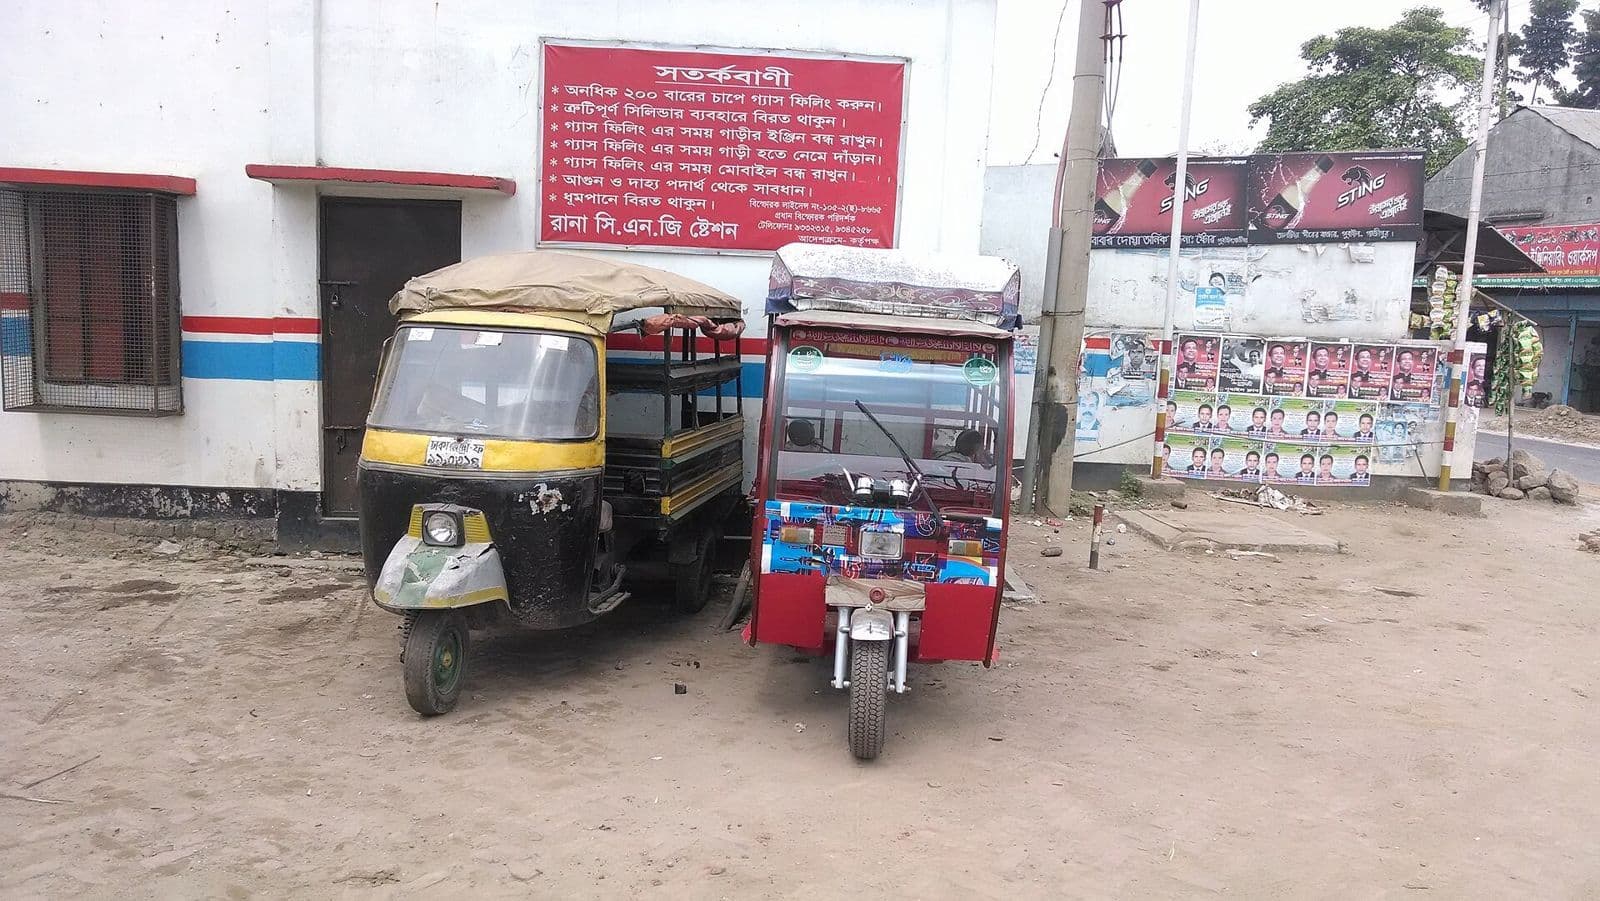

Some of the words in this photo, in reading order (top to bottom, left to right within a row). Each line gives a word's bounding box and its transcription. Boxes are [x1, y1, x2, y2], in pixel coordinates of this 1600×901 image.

[653, 65, 794, 88] সতর্কবাণী
[564, 83, 618, 98] অনধিক
[624, 88, 657, 100] ২০০
[663, 89, 706, 103] বারের
[711, 92, 745, 105] চাপে
[751, 93, 784, 107] গ্যাস
[789, 94, 832, 110] ফিলিং
[624, 103, 684, 120] সিলিন্ডার
[690, 109, 747, 123] ব্যবহারে
[753, 110, 790, 124] বিরত
[564, 120, 598, 133] গ্যাস
[603, 120, 647, 136] ফিলিং
[651, 125, 674, 137] এর
[680, 127, 713, 139] সময়
[719, 126, 762, 143] গাড়ীর
[767, 129, 806, 144] ইঞ্জিন
[811, 133, 834, 146] বন্ধ
[564, 138, 598, 151] গ্যাস
[603, 137, 646, 154] ফিলিং
[651, 143, 674, 155] এর
[680, 144, 713, 157] সময়
[718, 144, 751, 161] গাড়ী
[756, 149, 787, 160] হতে
[793, 150, 826, 163] নেমে
[563, 155, 597, 169] গ্যাস
[603, 155, 646, 172] ফিলিং
[650, 161, 673, 173] এর
[679, 162, 712, 175] সময়
[718, 163, 777, 178] মোবাইল
[784, 167, 806, 180] বন্ধ
[562, 174, 604, 188] আগুন
[610, 178, 622, 188] ও
[628, 178, 660, 191] দাহ্য
[666, 178, 706, 192] পদার্থ
[710, 181, 747, 193] থেকে
[1159, 177, 1211, 214] SNG
[1335, 172, 1388, 210] STING
[563, 192, 618, 207] ধূমপানে
[624, 192, 662, 207] বিরত
[549, 213, 588, 234] রানা
[594, 211, 682, 238] সি.এন.জি
[690, 216, 739, 240] ষ্টেশন
